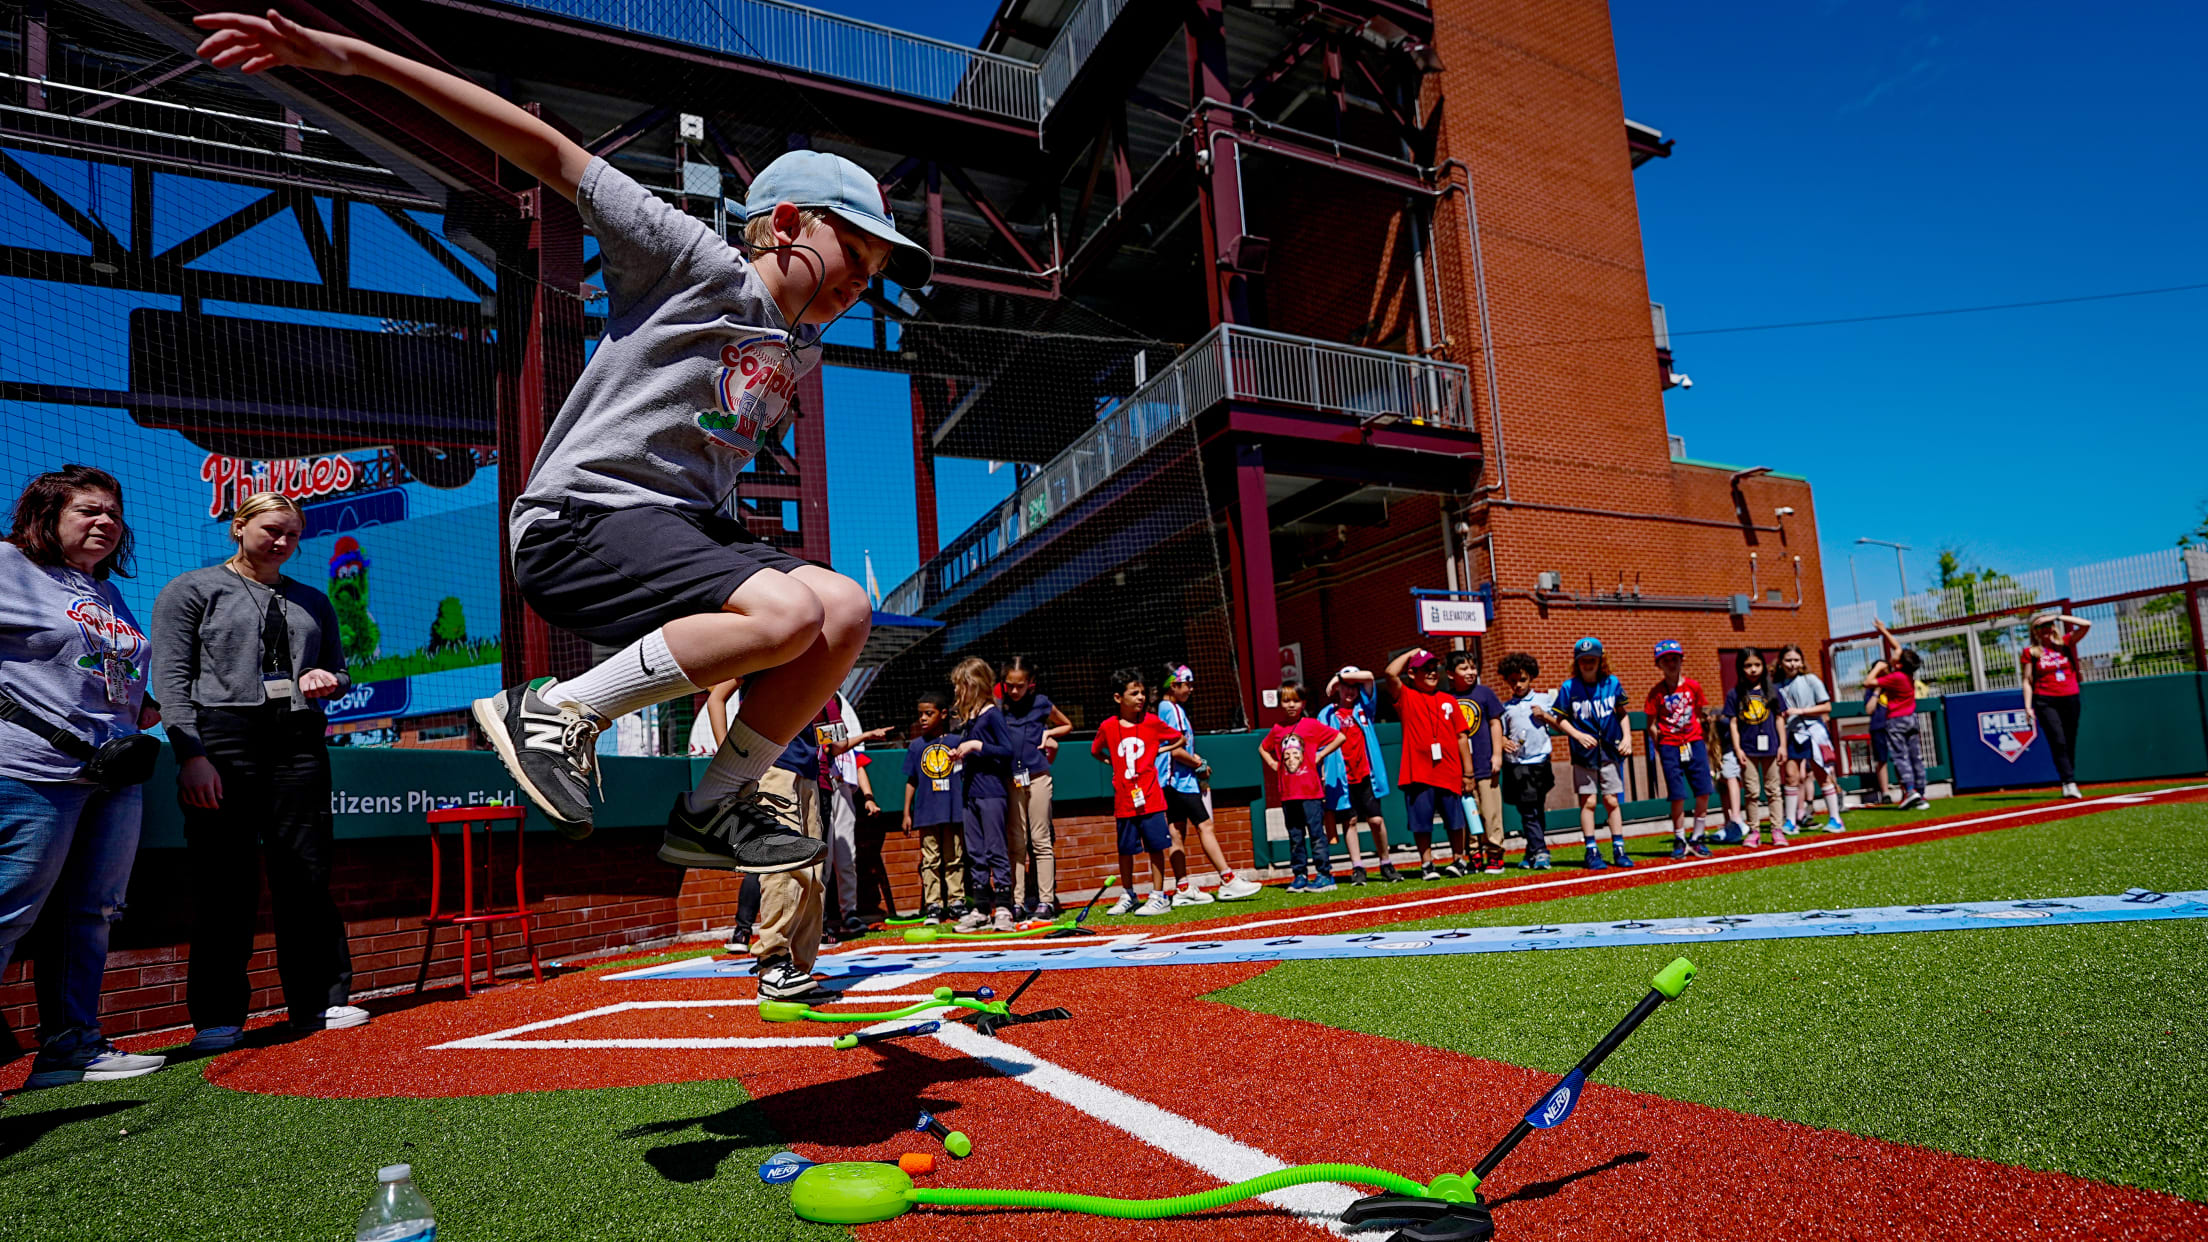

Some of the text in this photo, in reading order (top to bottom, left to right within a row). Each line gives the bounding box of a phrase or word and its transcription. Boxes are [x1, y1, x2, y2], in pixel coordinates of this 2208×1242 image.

[200, 453, 354, 518] Phillies
[1442, 609, 1477, 622] ELEVATORS
[1117, 737, 1145, 779] P
[331, 791, 402, 814] tizens
[1543, 1087, 1571, 1126] NERF
[766, 1165, 800, 1179] NERF
